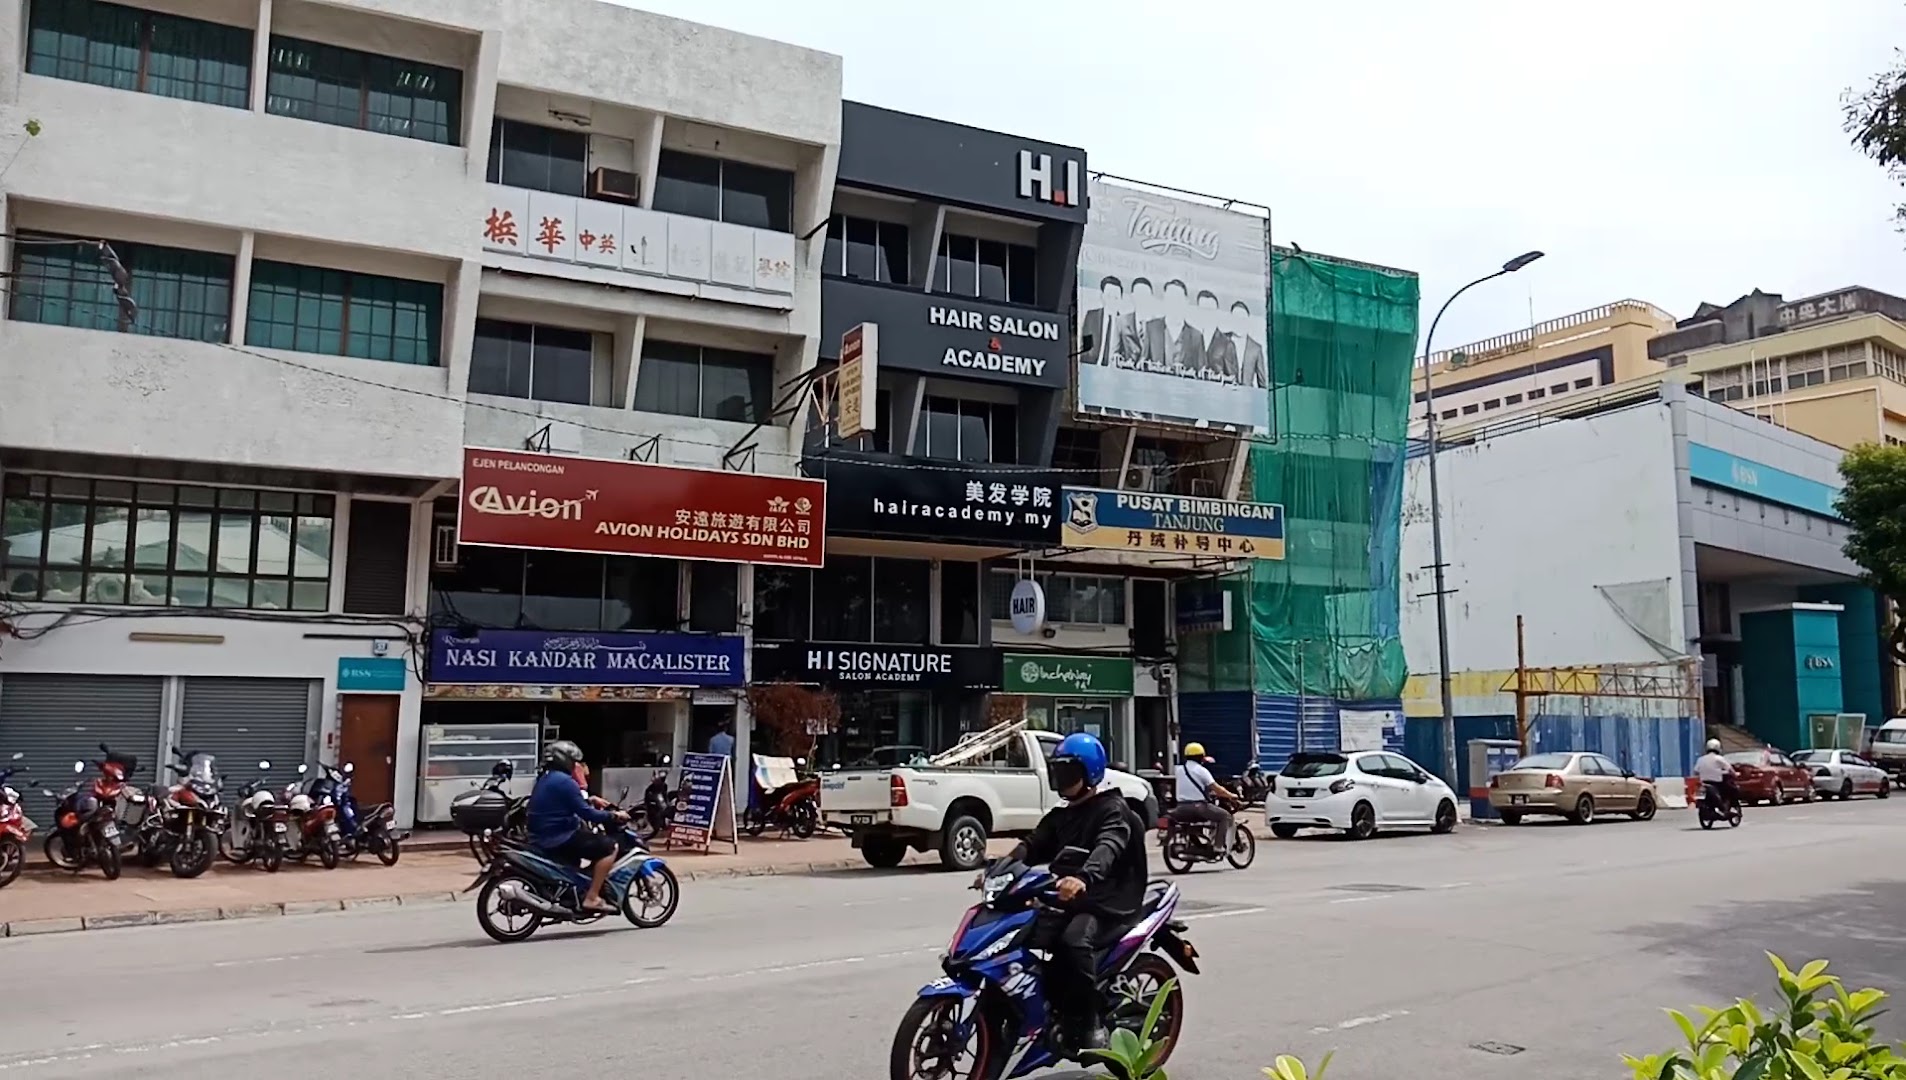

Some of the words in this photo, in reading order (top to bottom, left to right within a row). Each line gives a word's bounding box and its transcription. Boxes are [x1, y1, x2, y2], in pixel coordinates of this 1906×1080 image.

[1123, 196, 1220, 260] Tanjung
[928, 306, 984, 331] HAIR
[988, 313, 1059, 341] SALON
[987, 336, 1002, 351] &
[943, 347, 1046, 377] ACADEMY
[473, 458, 498, 469] EJEN
[498, 460, 565, 474] PELANCONGAN
[469, 486, 582, 520] Avion
[966, 480, 1052, 508] 美发学院
[1117, 494, 1174, 513] PUSAT
[1179, 500, 1275, 520] BIMBINGAN
[675, 509, 811, 535] 安遠旅遊有限公司
[1152, 513, 1225, 532] TANJUNG
[595, 522, 653, 537] AVION
[657, 526, 739, 544] HOLIDAYS
[742, 533, 774, 547] SDN
[777, 535, 809, 549] BHD
[1127, 531, 1255, 553] 丹绒补导中心
[1013, 597, 1035, 615] HAIR
[445, 649, 497, 667] NASI
[508, 650, 597, 669] KANDAR
[606, 652, 731, 671] MACALISTER
[838, 651, 952, 673] SIGNATURE
[839, 672, 872, 681] SALON
[875, 673, 921, 682] ACADEMY
